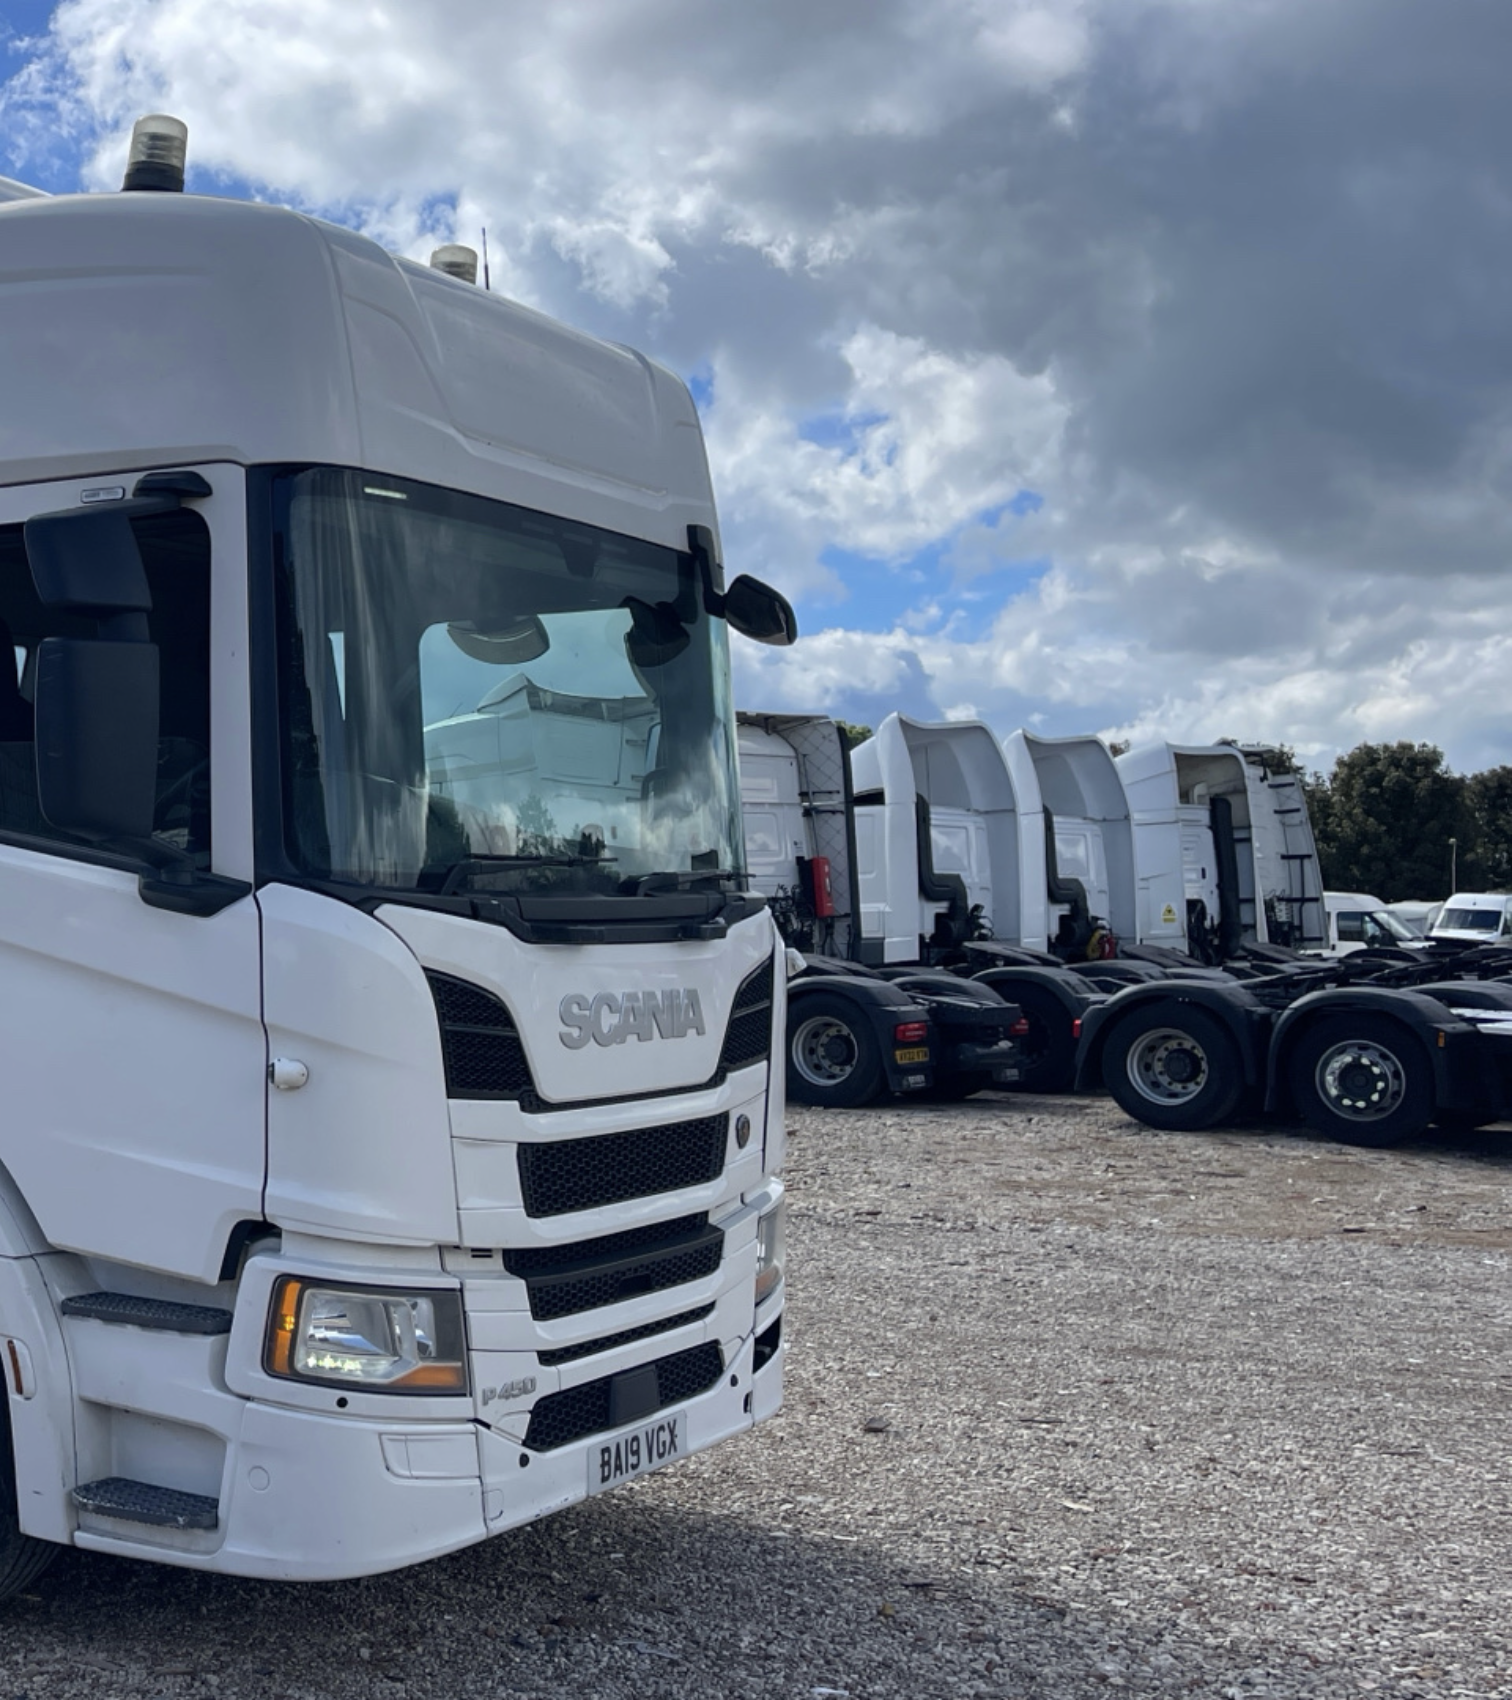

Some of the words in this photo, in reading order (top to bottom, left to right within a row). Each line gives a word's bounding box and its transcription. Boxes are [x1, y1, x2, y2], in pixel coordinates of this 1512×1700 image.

[558, 988, 707, 1051] SCANIA
[481, 1386, 497, 1406] P
[497, 1375, 537, 1401] 450
[600, 1434, 641, 1484] BA19
[645, 1418, 678, 1465] VGX
